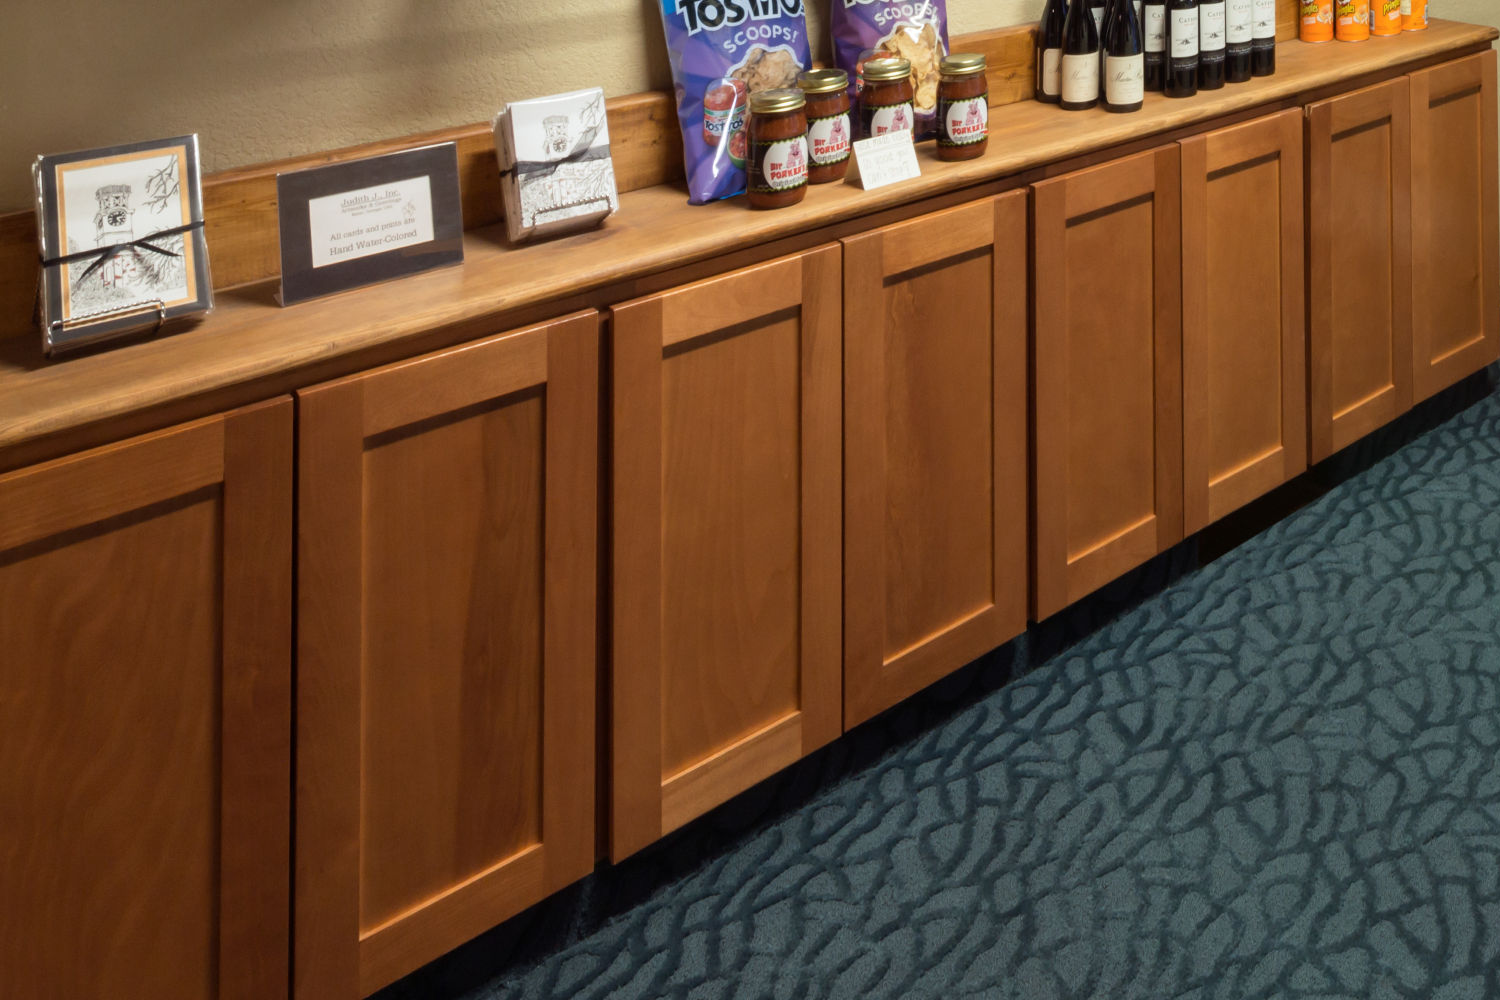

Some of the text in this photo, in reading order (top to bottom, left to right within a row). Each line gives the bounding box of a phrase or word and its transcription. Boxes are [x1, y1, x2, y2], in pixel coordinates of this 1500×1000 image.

[874, 1, 939, 26] SCOOPS!
[723, 26, 799, 54] SCOOPS!
[330, 217, 416, 241] All cards and prints are
[329, 229, 418, 256] Hand Water-Colored
